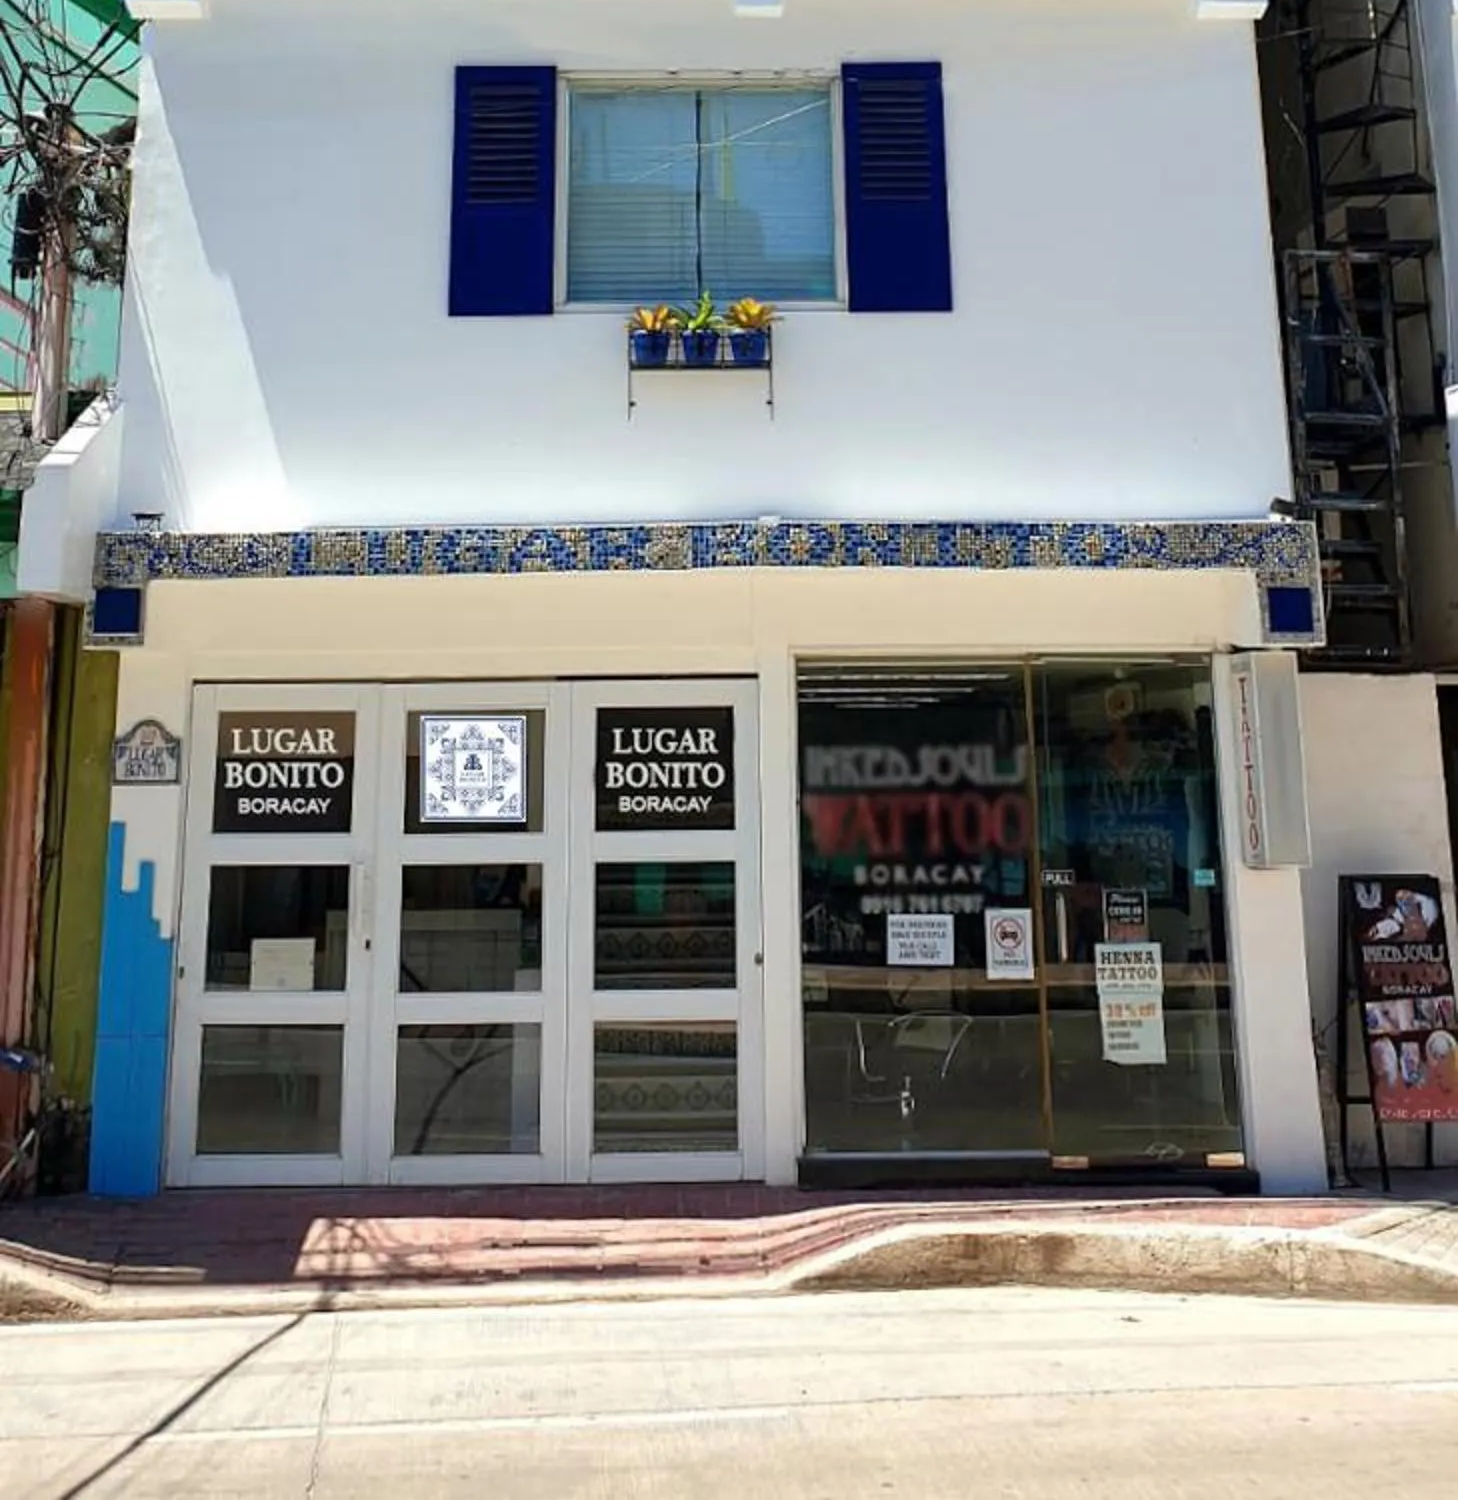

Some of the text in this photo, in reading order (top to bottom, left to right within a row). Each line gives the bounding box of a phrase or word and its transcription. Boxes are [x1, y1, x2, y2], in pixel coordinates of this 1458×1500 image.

[231, 728, 337, 755] LUGAR
[612, 728, 719, 755] LUGAR
[223, 761, 345, 789] BONITO
[605, 761, 726, 789] BONITO
[1238, 677, 1259, 850] TATTOO
[237, 798, 332, 815] BORACAY
[618, 796, 713, 813] BORACAY
[803, 793, 1031, 856] TATTOO
[853, 864, 984, 885] BORACAY
[1045, 873, 1072, 885] PULL
[1101, 951, 1155, 965] HENNA
[1098, 967, 1157, 980] TATTOO
